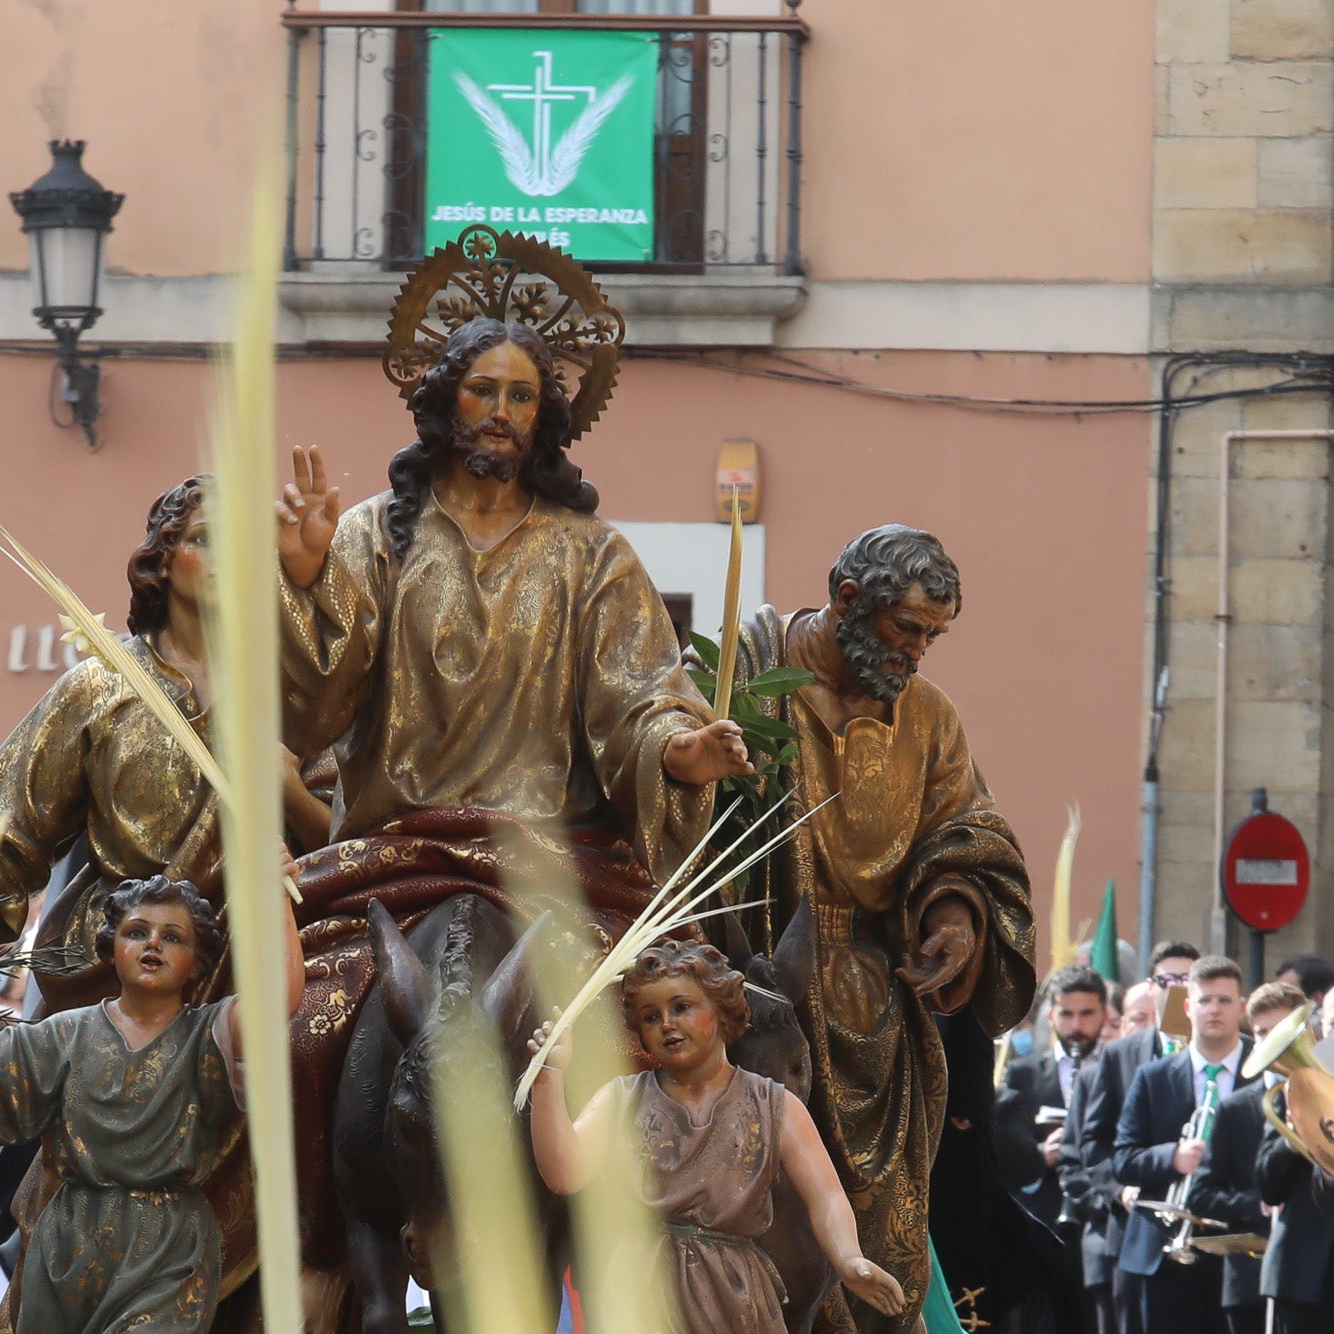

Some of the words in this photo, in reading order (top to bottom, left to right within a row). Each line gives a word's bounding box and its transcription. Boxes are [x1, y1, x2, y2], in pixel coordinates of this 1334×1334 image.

[432, 202, 485, 221] JESÚS
[490, 206, 513, 221] DE
[517, 207, 540, 222] LA
[545, 207, 648, 224] ESPERANZA
